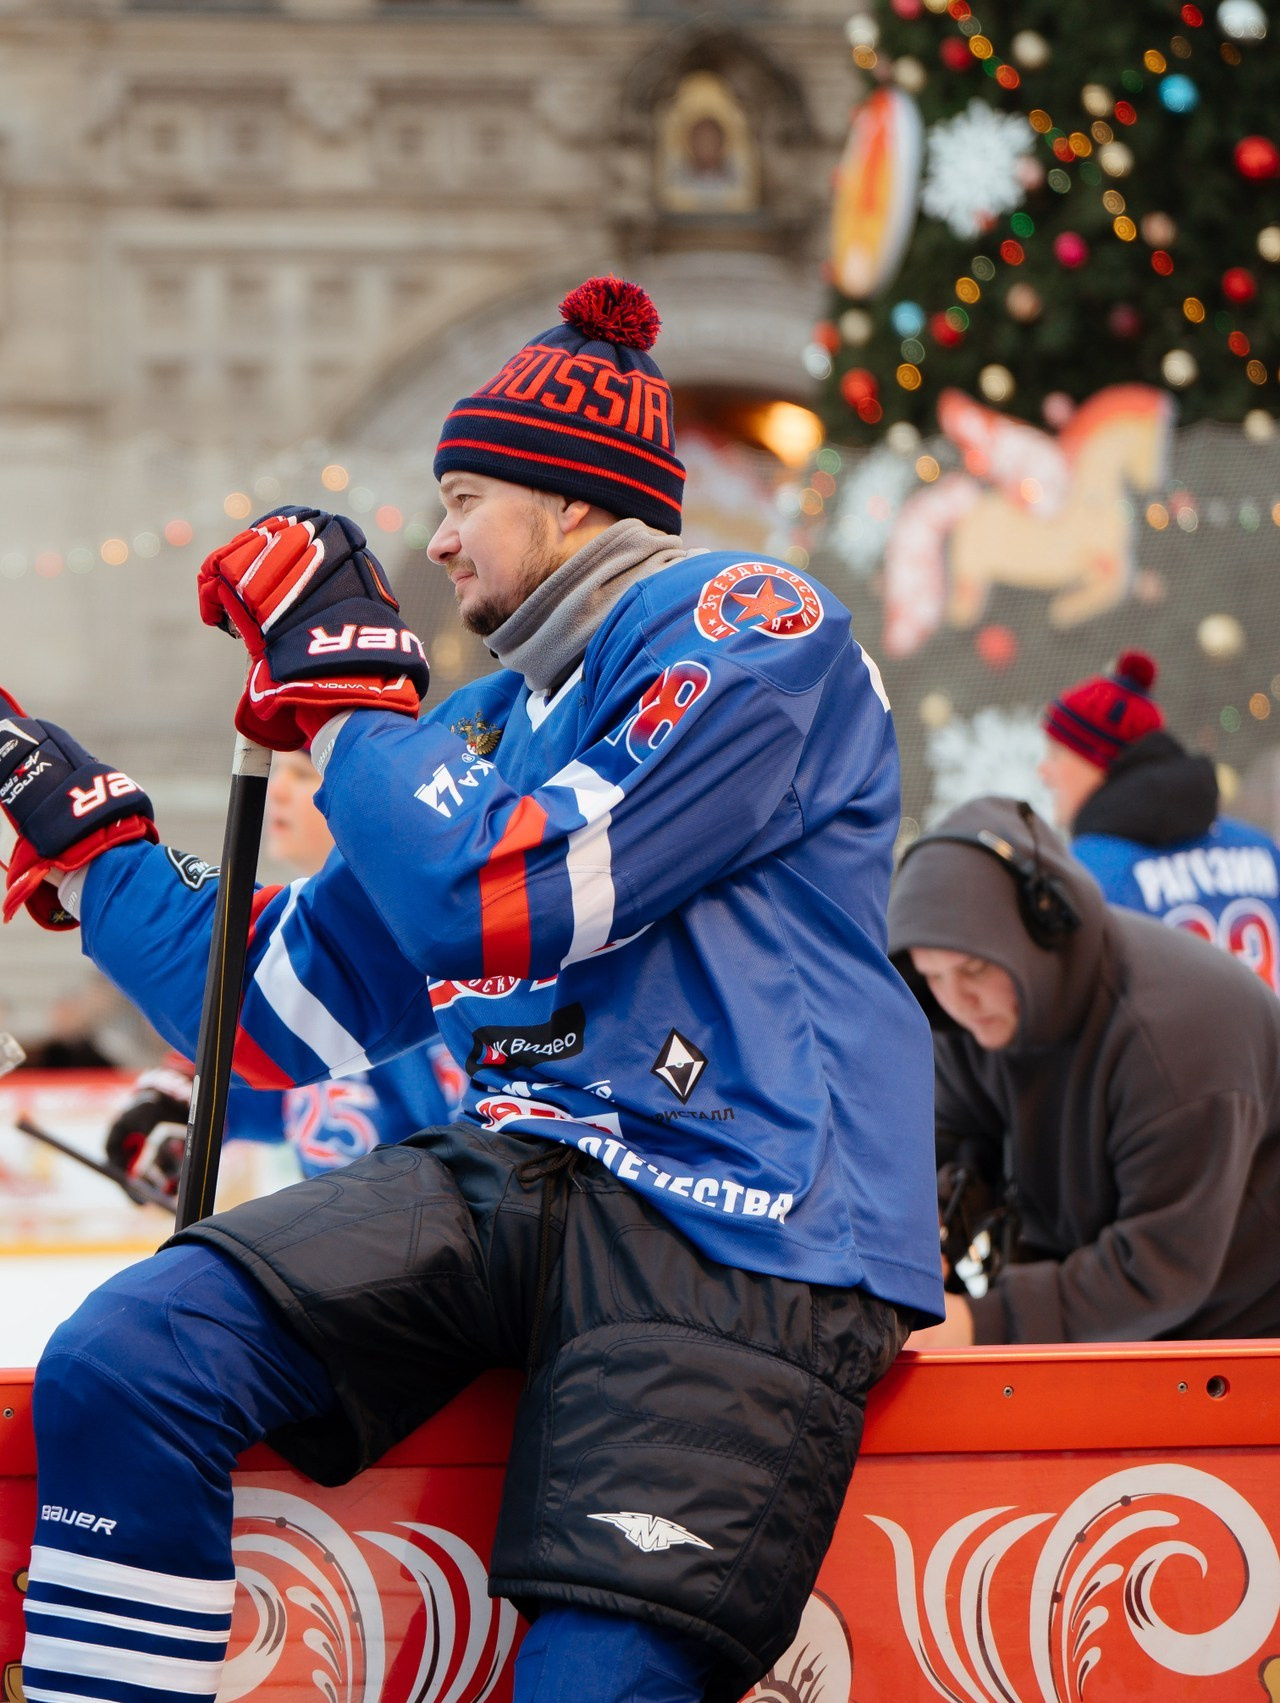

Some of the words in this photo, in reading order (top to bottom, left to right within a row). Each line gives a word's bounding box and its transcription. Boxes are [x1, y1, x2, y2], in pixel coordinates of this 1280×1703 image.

[477, 351, 670, 449] RUSSIA
[775, 567, 818, 627] РОССИИ
[314, 682, 367, 692] VAPOR
[1, 761, 52, 804] VAPOR
[510, 1032, 577, 1056] Видео
[653, 1106, 736, 1123] РИСТАЛЛ
